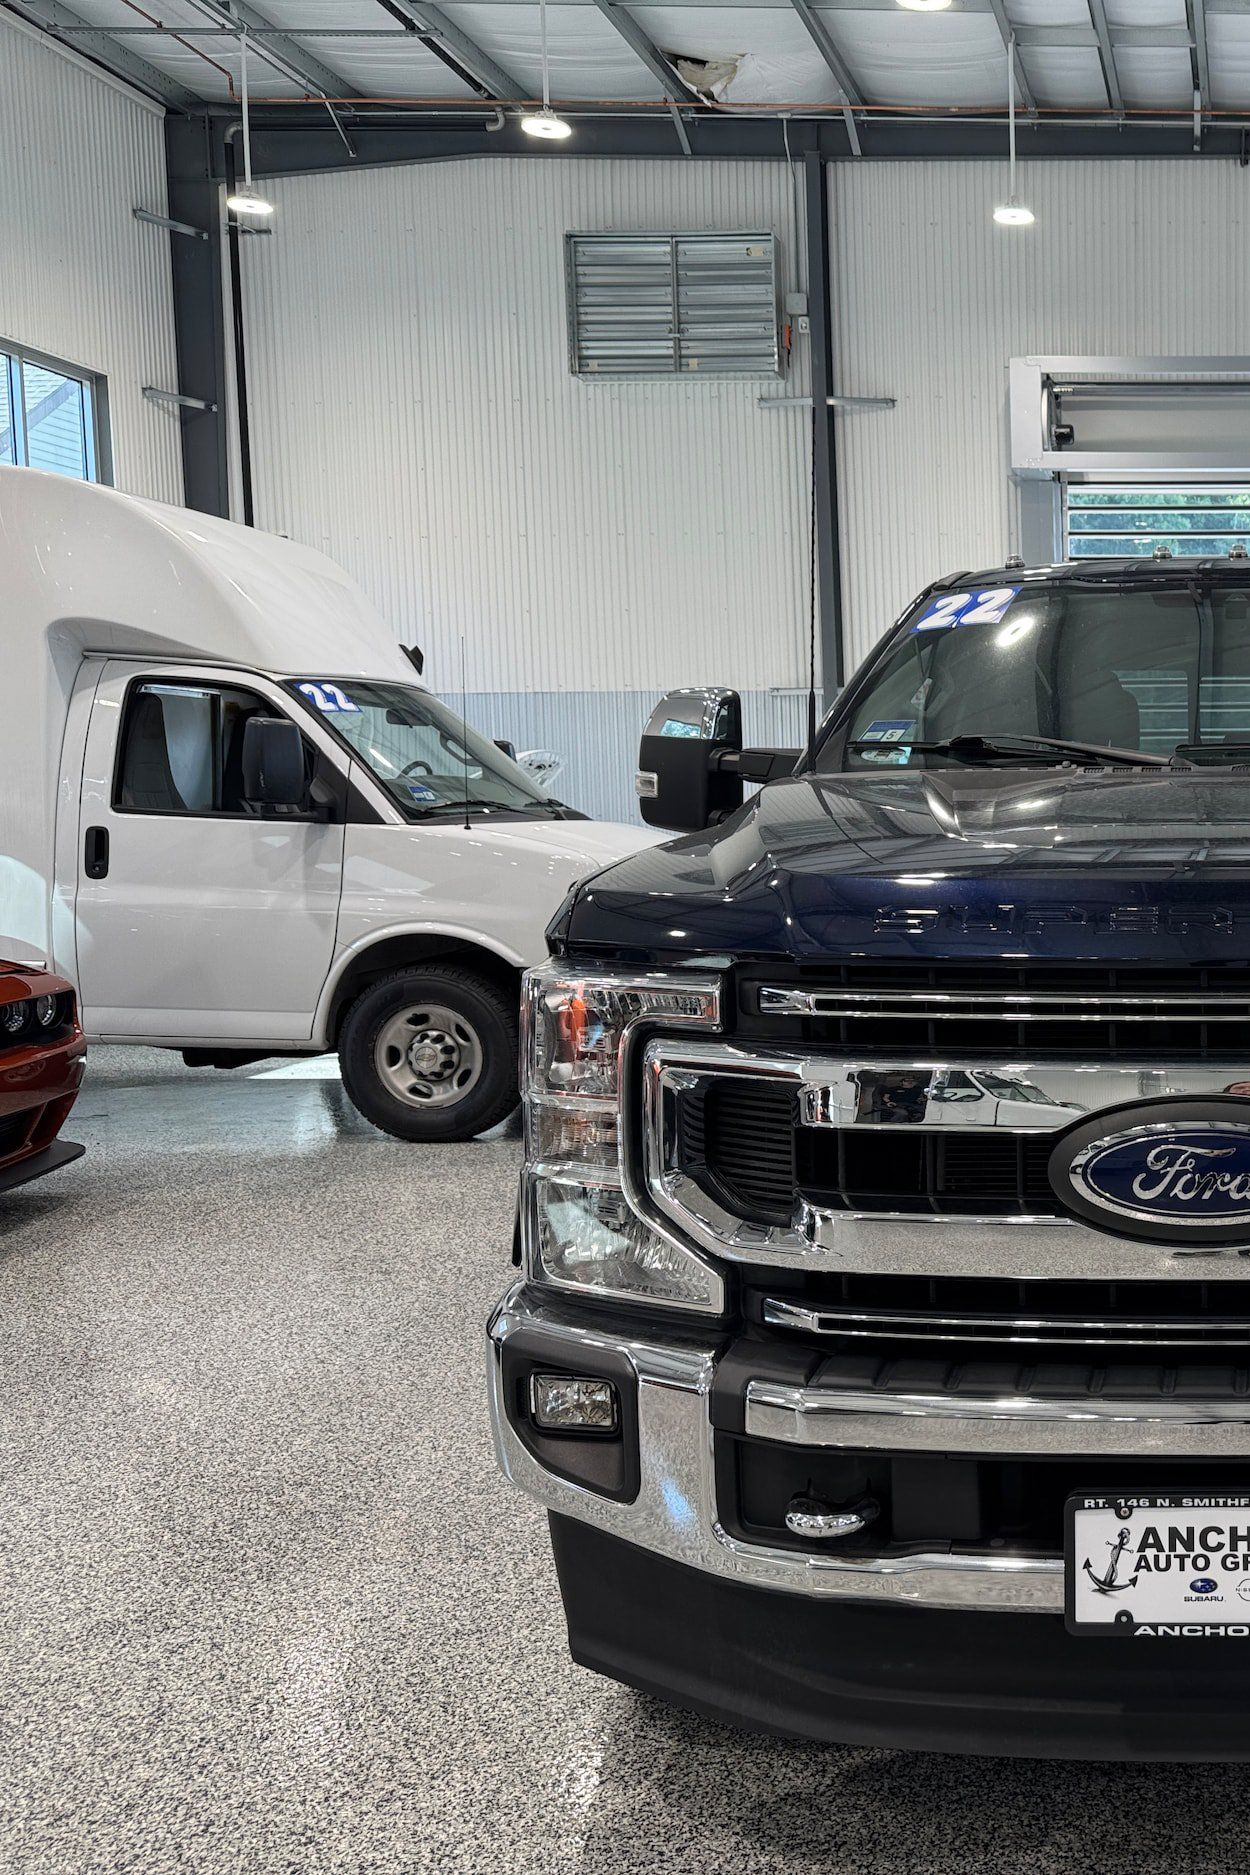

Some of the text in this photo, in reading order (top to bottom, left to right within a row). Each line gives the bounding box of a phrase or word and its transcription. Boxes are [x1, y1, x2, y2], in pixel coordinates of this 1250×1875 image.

[916, 588, 1018, 630] 22
[298, 683, 359, 711] 22
[873, 903, 1233, 934] SUPER
[1084, 1498, 1109, 1508] RT.
[1116, 1498, 1149, 1507] 146
[1156, 1498, 1175, 1507] N.
[1134, 1554, 1211, 1572] AUTO
